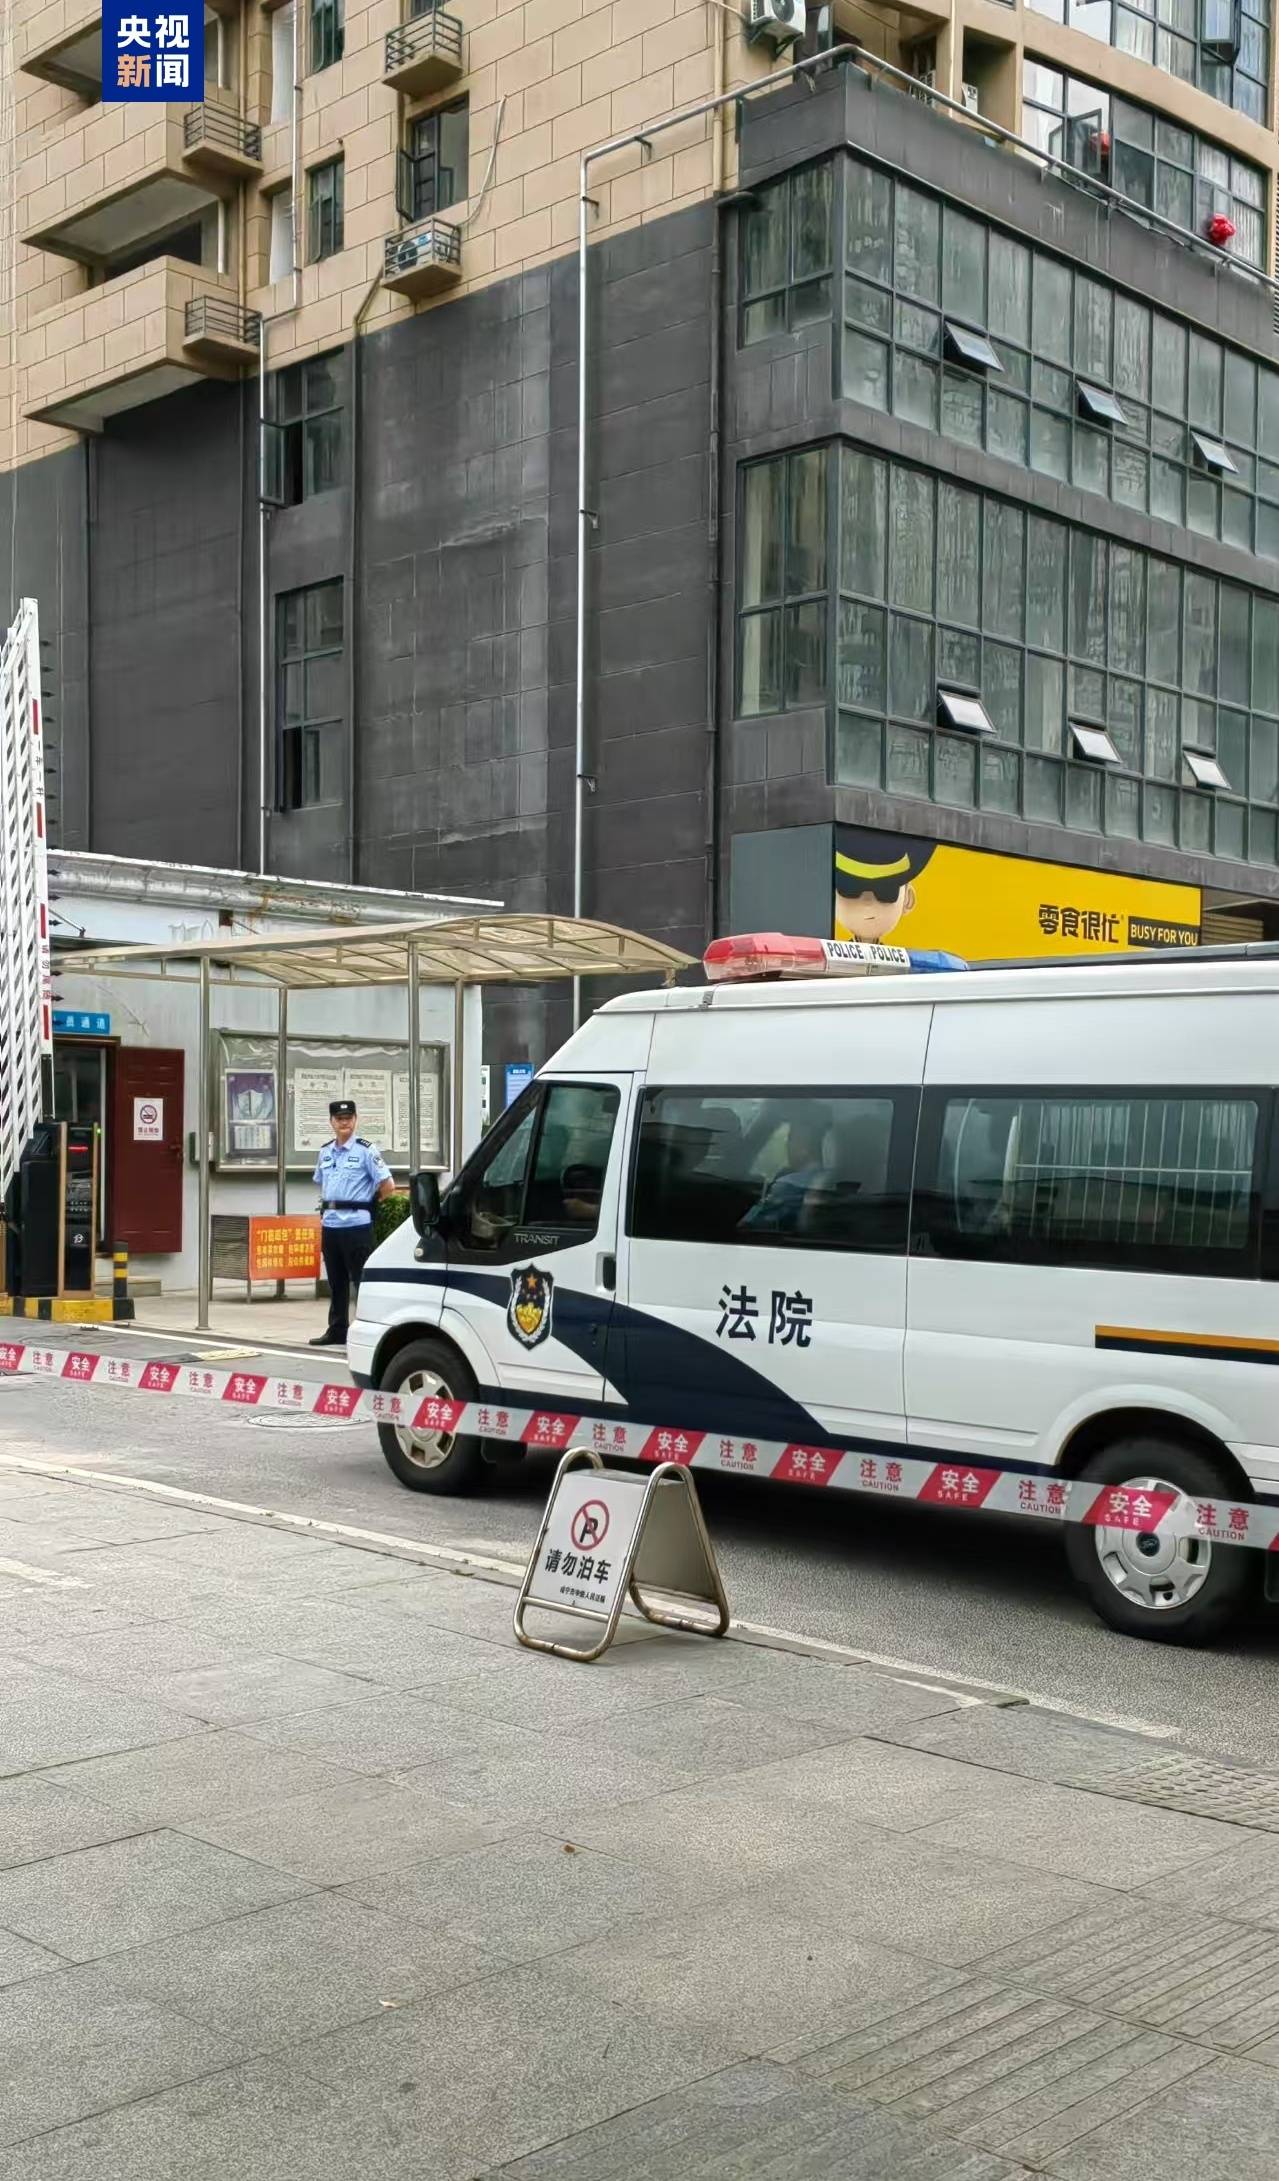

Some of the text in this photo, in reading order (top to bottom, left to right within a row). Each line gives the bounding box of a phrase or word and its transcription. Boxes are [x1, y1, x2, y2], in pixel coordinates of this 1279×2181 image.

[1039, 904, 1120, 944] 零食很忙
[1130, 923, 1198, 946] BUSY FOR YOU
[827, 942, 906, 963] POLICE POLICE
[513, 1233, 560, 1246] TRANSIT
[716, 1284, 814, 1348] 法院
[33, 1351, 54, 1366] 注意
[72, 1355, 90, 1372] 安全
[108, 1361, 130, 1377] 注意
[150, 1366, 170, 1382] 安全
[189, 1371, 214, 1388] 注意
[234, 1377, 256, 1394] 安全
[277, 1382, 304, 1400] 注意
[327, 1389, 351, 1407] 安全
[372, 1394, 401, 1413] 注意
[427, 1401, 453, 1421] 安全
[478, 1408, 509, 1428] 注意
[537, 1416, 566, 1436] 安全
[592, 1423, 627, 1444] 注意
[657, 1431, 689, 1454] 安全
[594, 1442, 624, 1452] CAUTION
[719, 1440, 758, 1462] 注意
[721, 1460, 754, 1471] CAUTION
[792, 1449, 826, 1472] 安全
[860, 1459, 903, 1483] 注意
[862, 1479, 899, 1491] CAUTION
[942, 1469, 979, 1493] 安全
[938, 1490, 968, 1501] SAFE
[1018, 1480, 1066, 1505] 注意
[1020, 1502, 1061, 1514] CAUTION
[1109, 1492, 1152, 1518] 安全
[1105, 1514, 1140, 1527] SAFE
[1196, 1503, 1249, 1530] 注意
[1199, 1527, 1244, 1541] CAUTION
[545, 1549, 612, 1584] 请勿泊车
